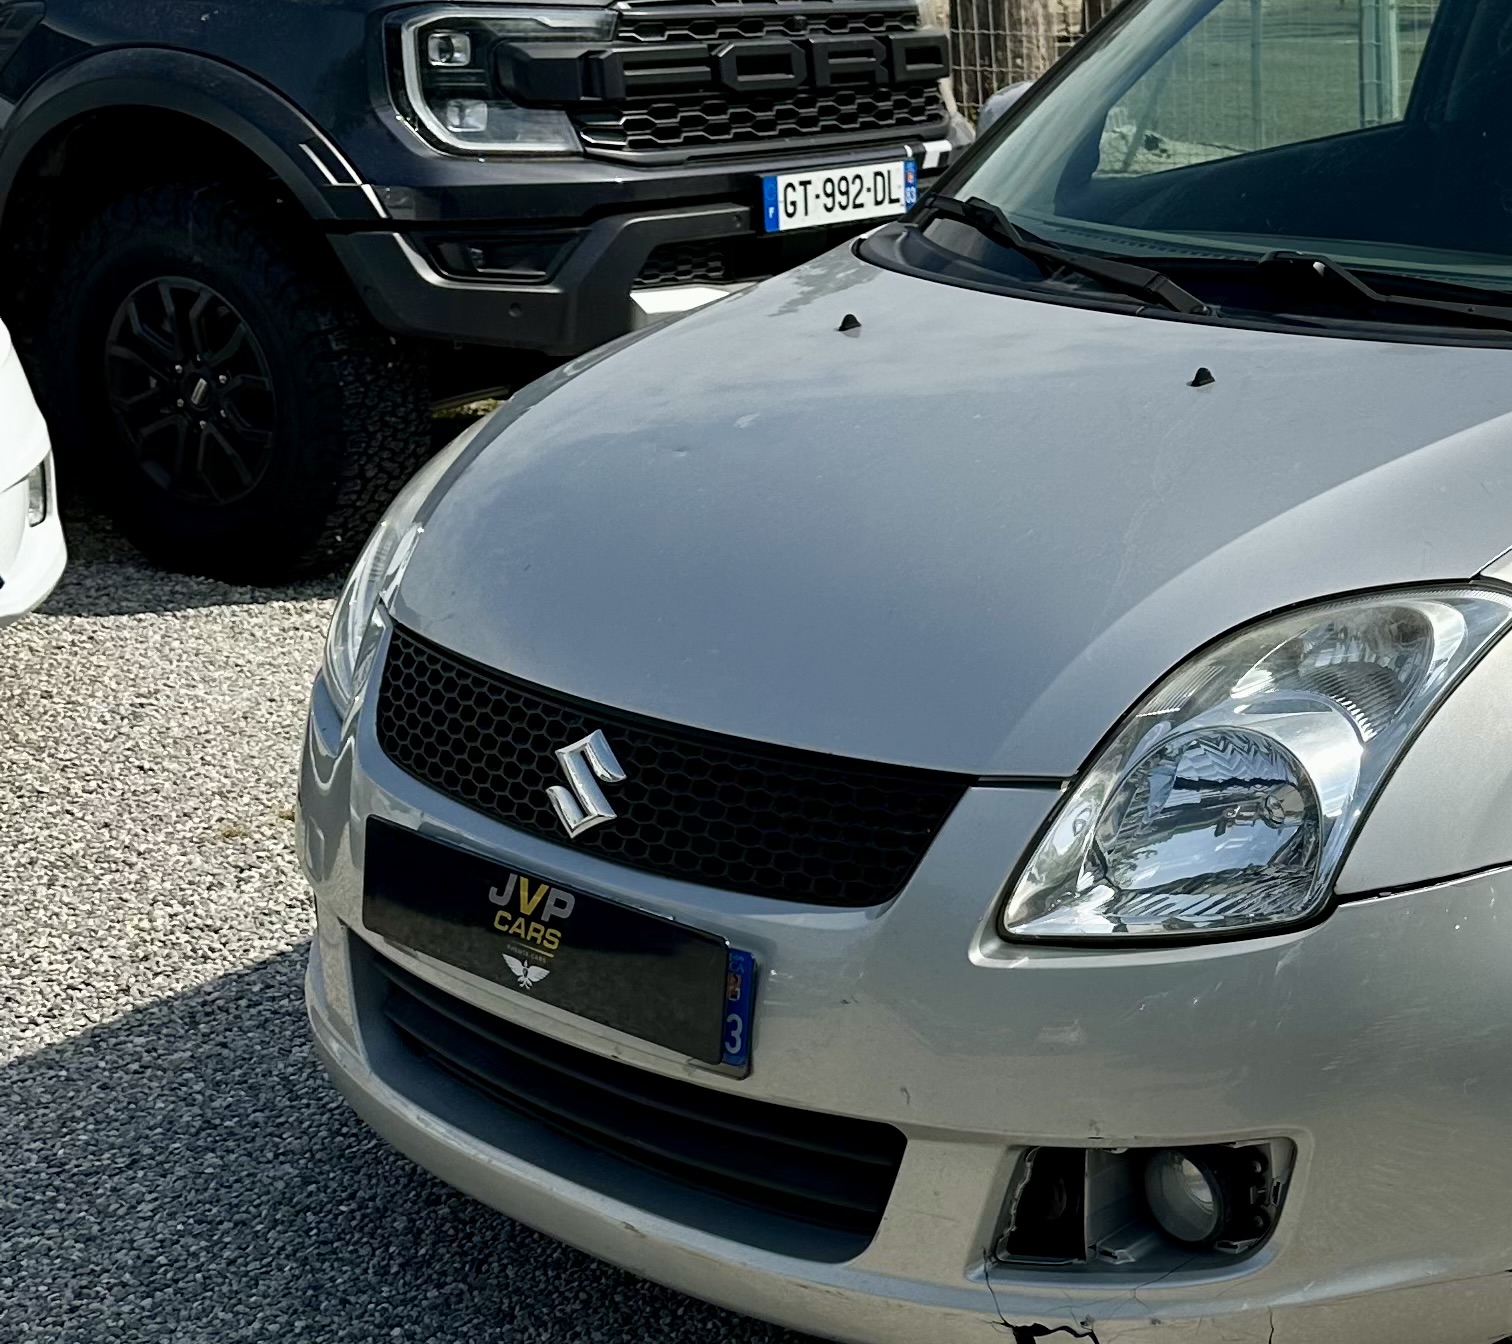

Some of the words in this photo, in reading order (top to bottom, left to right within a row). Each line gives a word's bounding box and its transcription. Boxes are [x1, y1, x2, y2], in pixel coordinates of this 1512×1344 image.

[596, 29, 950, 102] FORD
[768, 207, 775, 219] F
[783, 169, 900, 219] GT-992-DL
[488, 872, 576, 923] JVP
[493, 909, 562, 950] CARS
